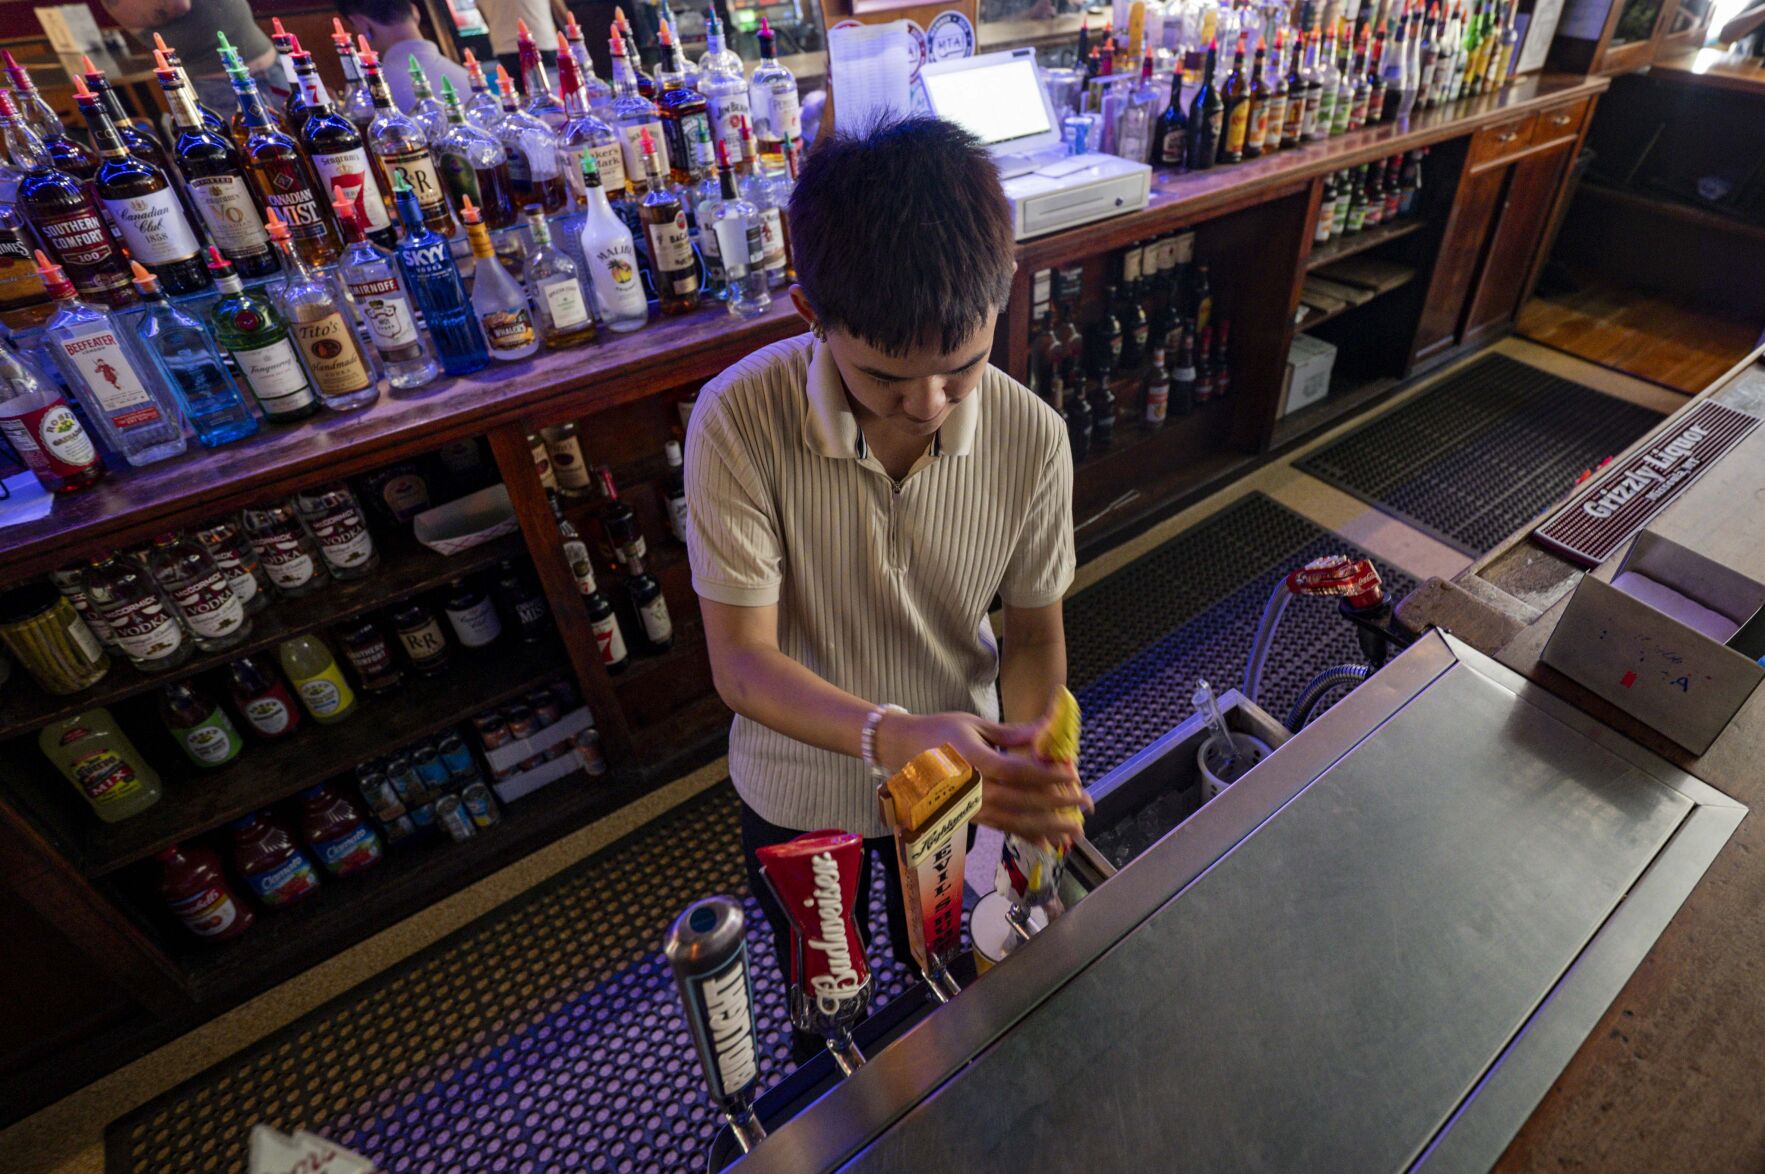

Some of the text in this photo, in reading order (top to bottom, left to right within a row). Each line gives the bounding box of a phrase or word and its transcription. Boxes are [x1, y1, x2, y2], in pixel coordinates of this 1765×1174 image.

[268, 188, 314, 207] CANADIAN
[120, 205, 170, 222] Canadian
[41, 216, 100, 239] SOUTHERN
[136, 219, 163, 234] Club
[0, 240, 30, 257] IMES
[51, 229, 104, 250] COMFORT
[77, 251, 101, 263] 100
[402, 244, 445, 266] SKYY
[299, 321, 339, 341] Tito's
[65, 334, 117, 357] BEEFEATER
[311, 354, 358, 371] Handmade
[1583, 422, 1708, 519] Grizzly Liquor
[322, 522, 365, 546] VODKA
[185, 589, 234, 615] VODKA
[116, 613, 169, 638] VODKA
[91, 766, 131, 797] MIX
[803, 851, 860, 1016] Budweiser
